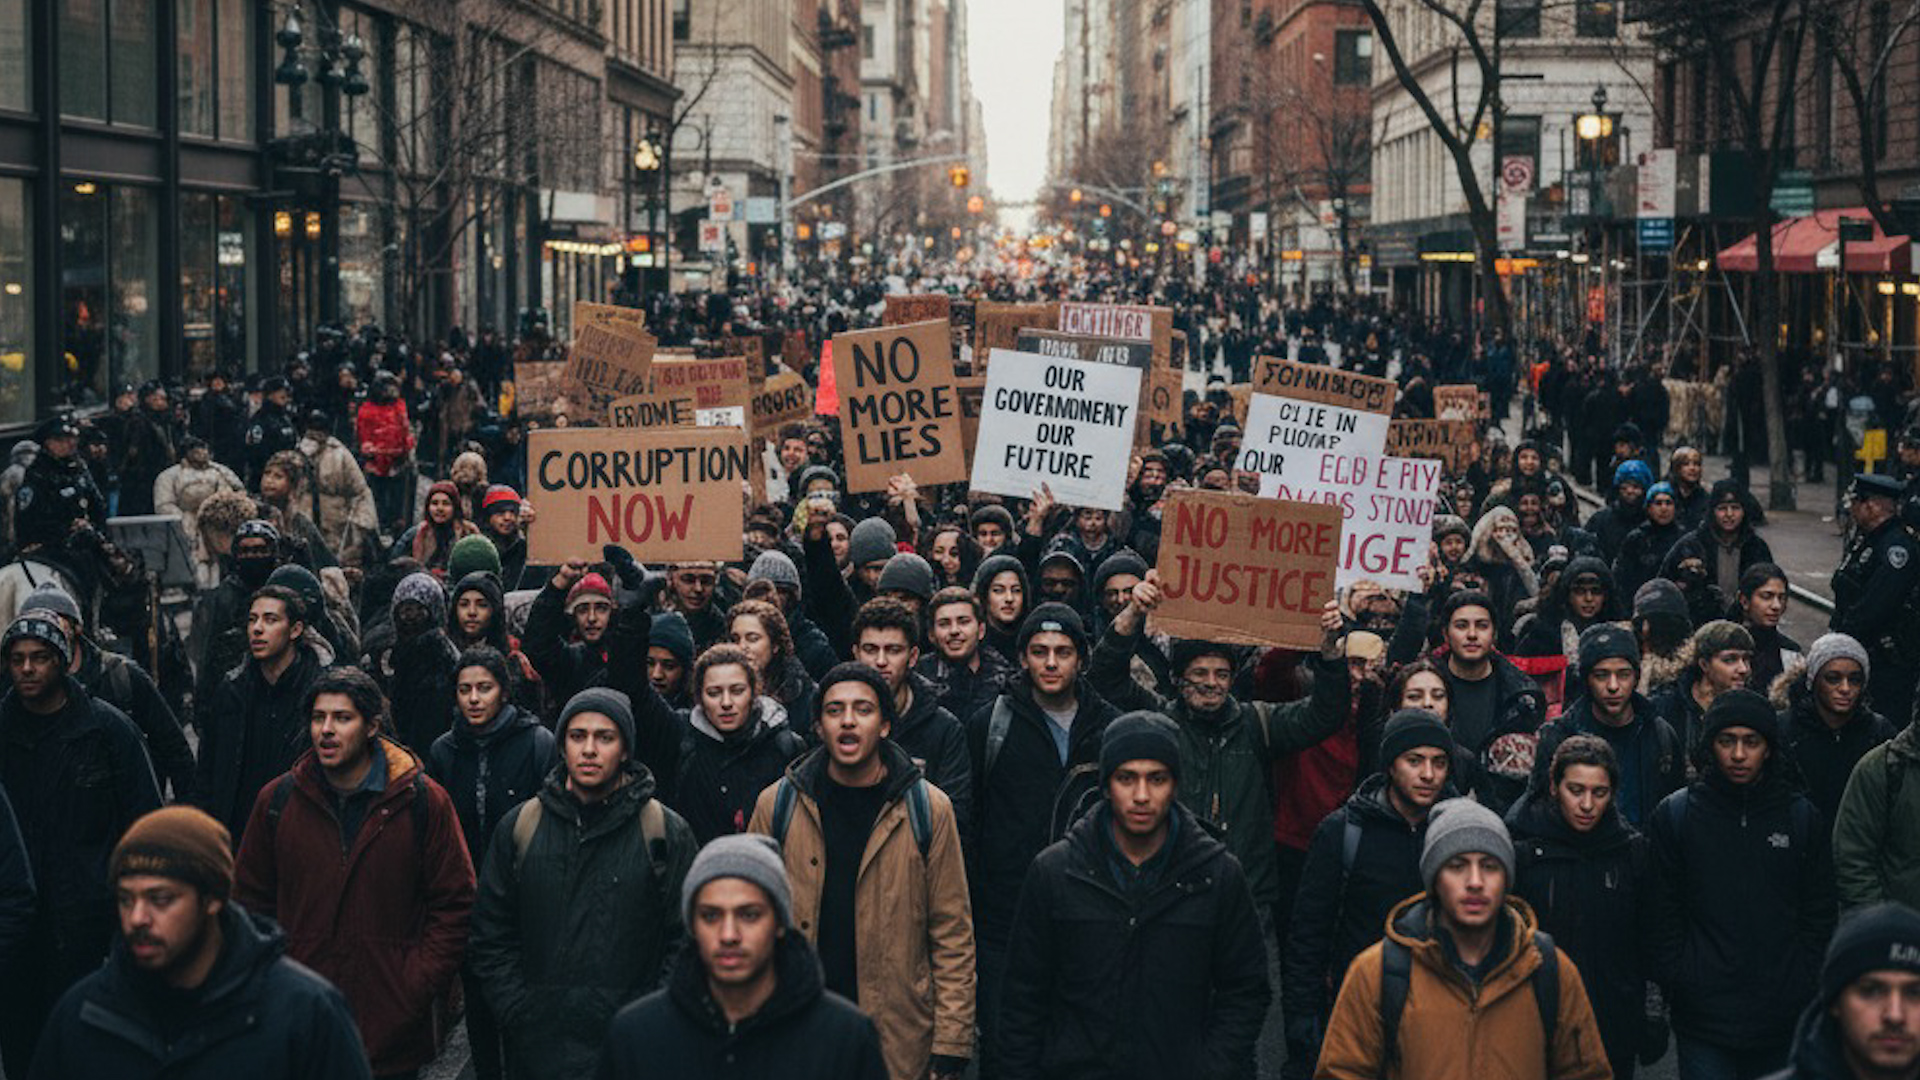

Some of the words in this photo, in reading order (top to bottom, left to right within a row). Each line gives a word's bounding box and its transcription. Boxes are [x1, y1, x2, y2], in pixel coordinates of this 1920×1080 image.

[852, 336, 919, 387] NO
[1045, 365, 1085, 392] OUR
[849, 385, 953, 429] MORE
[1336, 412, 1358, 433] IN
[857, 424, 942, 465] LIES
[1036, 423, 1075, 447] OUR
[538, 445, 750, 491] CORRUPTION
[1004, 445, 1094, 480] FUTURE
[1243, 449, 1285, 475] OUR
[587, 493, 694, 544] NOW
[1174, 502, 1229, 549] NO
[1250, 515, 1333, 557] MORE
[1162, 555, 1327, 615] JUSTICE
